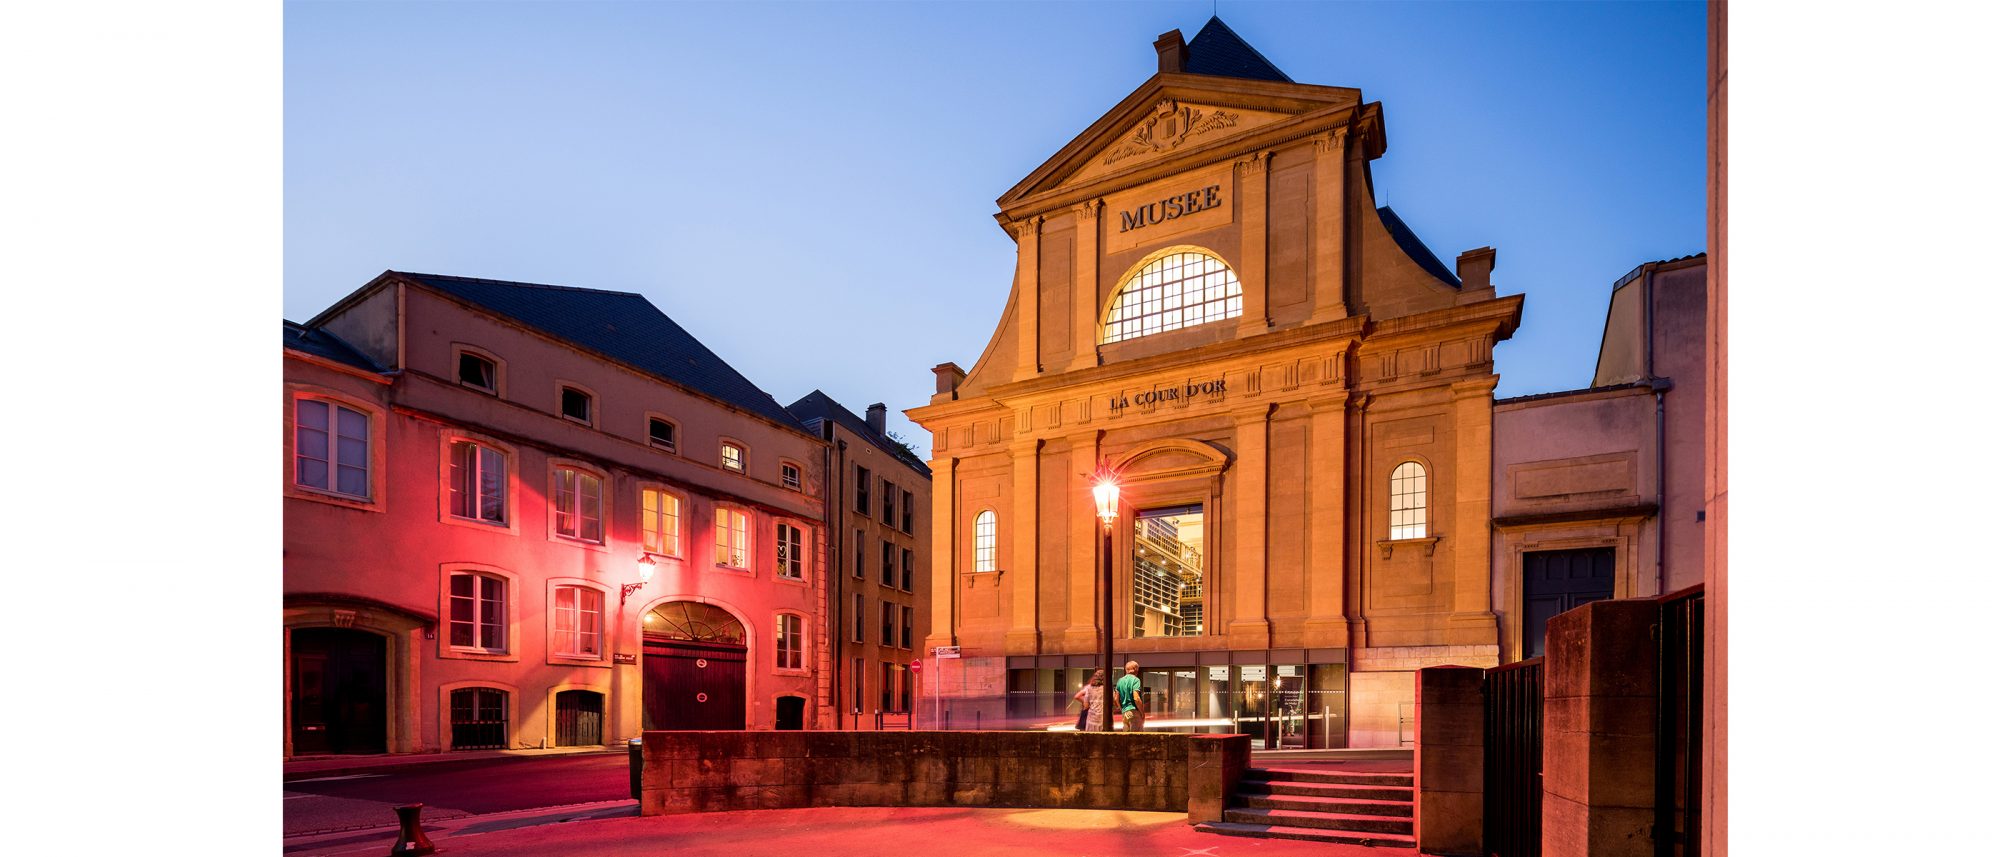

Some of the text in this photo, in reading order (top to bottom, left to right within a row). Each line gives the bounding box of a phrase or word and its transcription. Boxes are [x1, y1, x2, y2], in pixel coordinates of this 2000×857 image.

[1120, 185, 1222, 233] MUSEE
[1110, 379, 1227, 411] LA COUR D'OR
